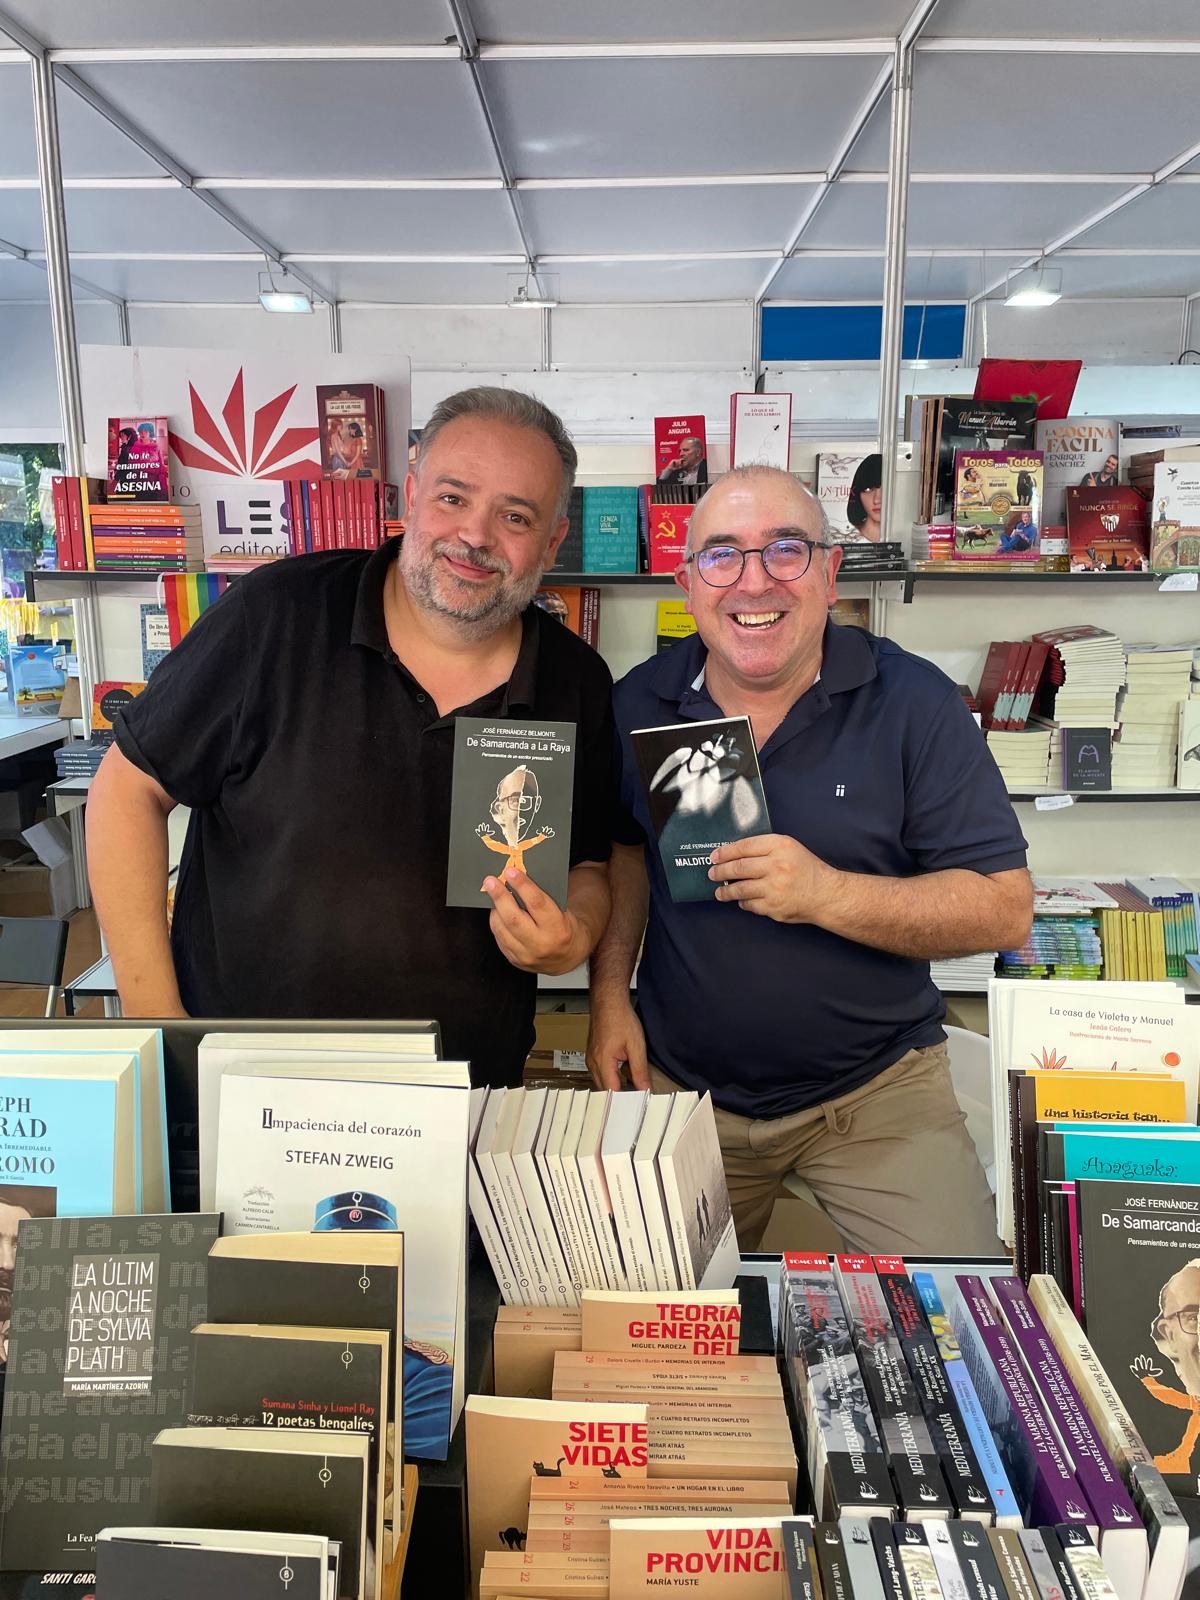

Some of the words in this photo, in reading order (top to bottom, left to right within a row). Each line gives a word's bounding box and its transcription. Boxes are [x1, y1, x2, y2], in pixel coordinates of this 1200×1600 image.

[116, 462, 160, 471] enamores
[962, 456, 995, 468] Toros
[1007, 456, 1041, 468] Todos
[126, 472, 137, 480] de
[140, 471, 148, 479] la
[114, 481, 162, 492] ASESINA
[1080, 504, 1106, 512] NUNCA
[497, 728, 528, 736] FERNÁNDEZ
[467, 738, 479, 747] De
[480, 738, 529, 750] Samarcanda
[538, 742, 548, 751] La
[550, 743, 571, 754] Raya
[675, 857, 714, 867] MALDITO
[1050, 1007, 1060, 1016] La
[1063, 1009, 1083, 1018] casa
[1086, 1010, 1096, 1019] de
[1098, 1012, 1130, 1022] Violeta
[1132, 1016, 1138, 1024] y
[1140, 1017, 1174, 1026] Manuel
[263, 1108, 345, 1133] Impaciencia
[348, 1122, 367, 1134] del
[371, 1125, 422, 1138] corazón
[1044, 1109, 1069, 1118] Una
[1072, 1109, 1130, 1121] historia
[0, 1156, 55, 1174] OMO
[285, 1150, 341, 1166] STEFAN
[346, 1154, 394, 1170] ZWEIG
[1125, 1197, 1147, 1208] JOSÉ
[1148, 1199, 1199, 1211] FERNÁNDEZ
[1102, 1214, 1120, 1228] De
[1128, 1238, 1169, 1247] Pensamientos
[74, 1263, 96, 1287] LA
[102, 1258, 154, 1286] ÚLTIM
[70, 1291, 83, 1314] A
[89, 1289, 153, 1314] NOCHE
[70, 1318, 93, 1343] DE
[97, 1317, 152, 1342] SYLVIA
[629, 1322, 740, 1340] GENERAL
[67, 1346, 124, 1371] PLATH
[1075, 1341, 1094, 1365] MAR
[71, 1383, 91, 1392] MARÍA
[92, 1382, 124, 1391] MARTÍNEZ
[125, 1382, 149, 1390] AZORÍN
[997, 1356, 1028, 1409] REPUBLICANA
[1010, 1361, 1030, 1393] ESPAÑOLA
[1038, 1358, 1069, 1413] REPUBLICANA
[1051, 1363, 1071, 1397] ESPAÑOLA
[1093, 1372, 1108, 1391] POR
[262, 1398, 296, 1411] Sumana
[298, 1400, 321, 1412] Sinha
[323, 1405, 329, 1414] y
[331, 1403, 357, 1413] Lionel
[360, 1404, 376, 1416] Ray
[1024, 1390, 1037, 1410] CIVIL
[1065, 1394, 1079, 1413] CIVIL
[1100, 1387, 1120, 1413] VIENE
[262, 1412, 274, 1425] 12
[278, 1416, 316, 1429] poetas
[320, 1415, 375, 1431] bengalíes
[1020, 1406, 1043, 1443] MARINA
[1032, 1407, 1050, 1437] GUERRA
[1062, 1410, 1085, 1446] MARINA
[1073, 1410, 1092, 1440] GUERRA
[1114, 1411, 1140, 1450] ENEMIGO
[569, 1422, 648, 1443] SIETE
[837, 1411, 868, 1474] MEDITERRANÍA
[892, 1412, 926, 1476] MEDITERRANÍA
[936, 1413, 973, 1478] MEDITERRANÍA
[1036, 1441, 1048, 1455] LA
[1078, 1444, 1090, 1458] LA
[562, 1445, 648, 1467] VIDAS
[1049, 1444, 1070, 1480] DURANTE
[1090, 1446, 1113, 1484] DURANTE
[67, 1534, 77, 1543] La
[79, 1534, 93, 1543] Fea
[706, 1528, 772, 1550] VIDA
[646, 1552, 784, 1573] PROVINCI
[41, 1574, 73, 1585] SANTI
[284, 1570, 290, 1579] 8
[646, 1578, 672, 1586] MARÍA
